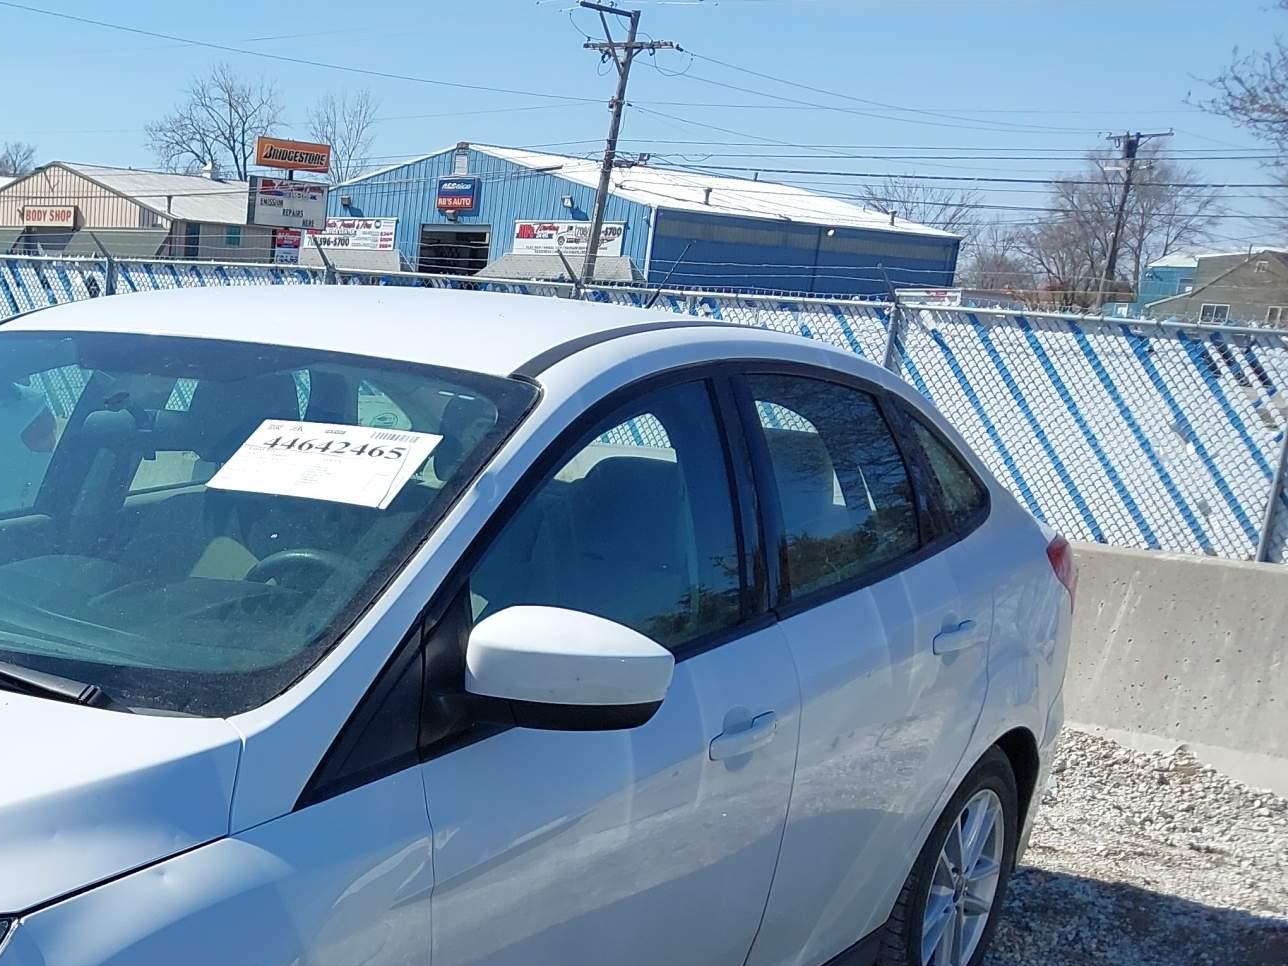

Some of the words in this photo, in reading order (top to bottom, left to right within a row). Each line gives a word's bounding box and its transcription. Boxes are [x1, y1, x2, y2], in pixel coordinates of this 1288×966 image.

[263, 144, 327, 166] BRIDGESTONE
[452, 197, 471, 206] AUTO
[25, 209, 47, 222] BODY
[49, 209, 72, 222] SHOP
[282, 208, 304, 218] REPAIRS
[319, 236, 350, 247] 596-5700
[264, 436, 407, 459] 44642465
